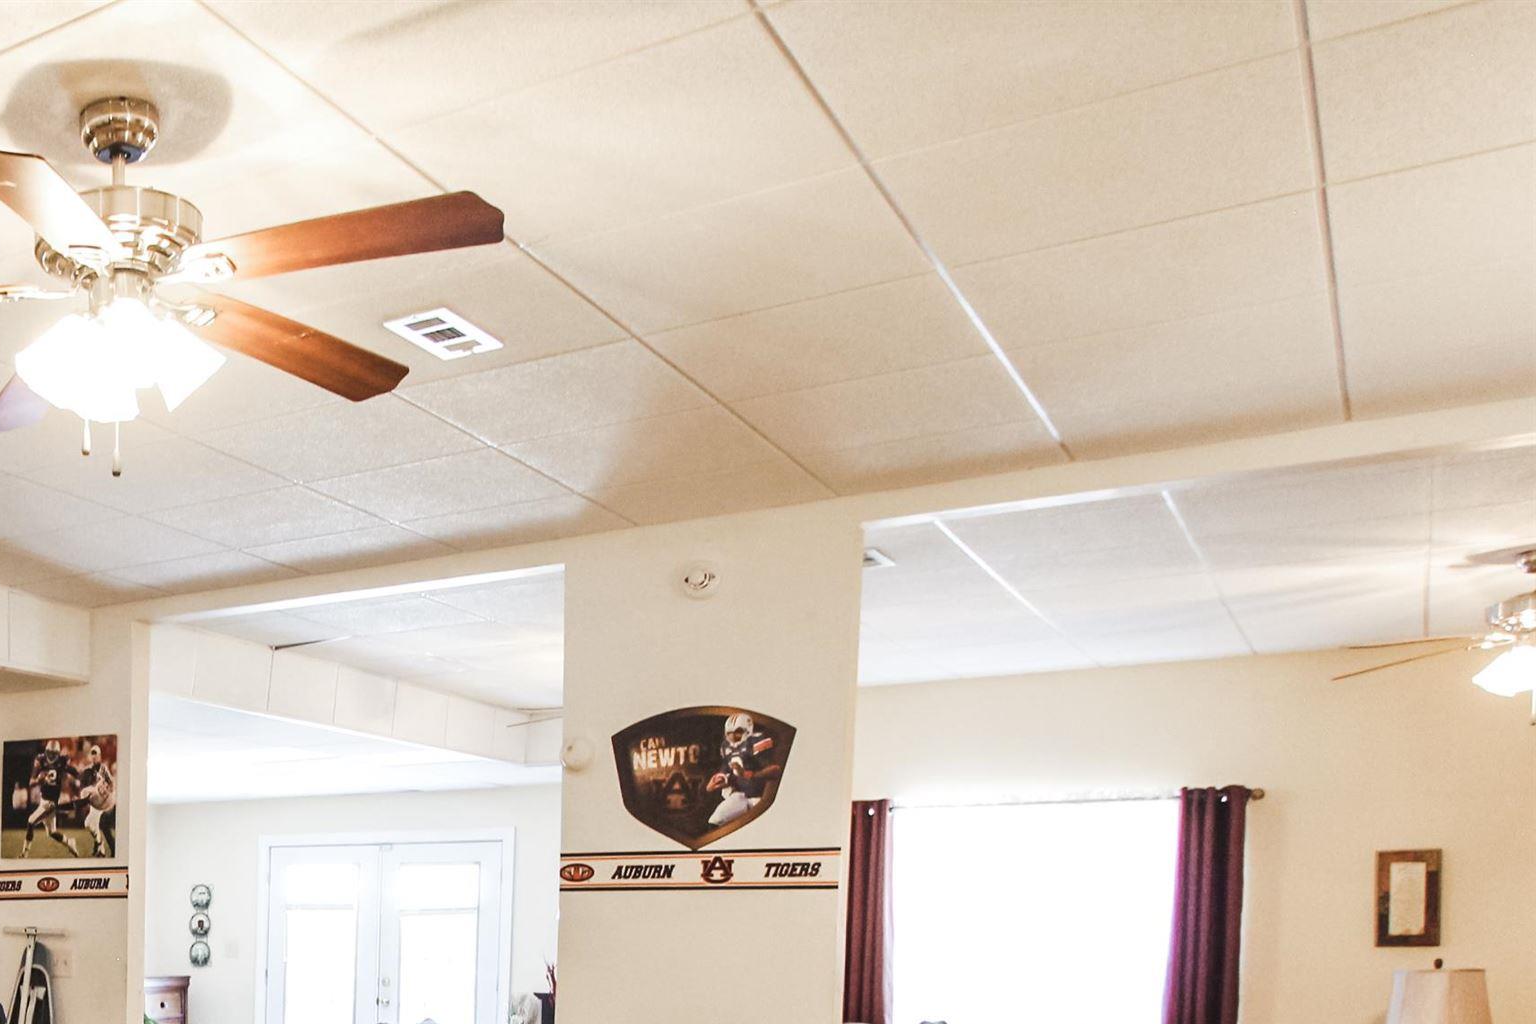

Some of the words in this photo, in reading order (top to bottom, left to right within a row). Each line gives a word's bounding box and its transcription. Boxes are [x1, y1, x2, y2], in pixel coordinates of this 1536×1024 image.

[611, 864, 675, 879] AUBURN
[764, 862, 822, 877] TIGERS
[70, 878, 110, 890] AUBURN
